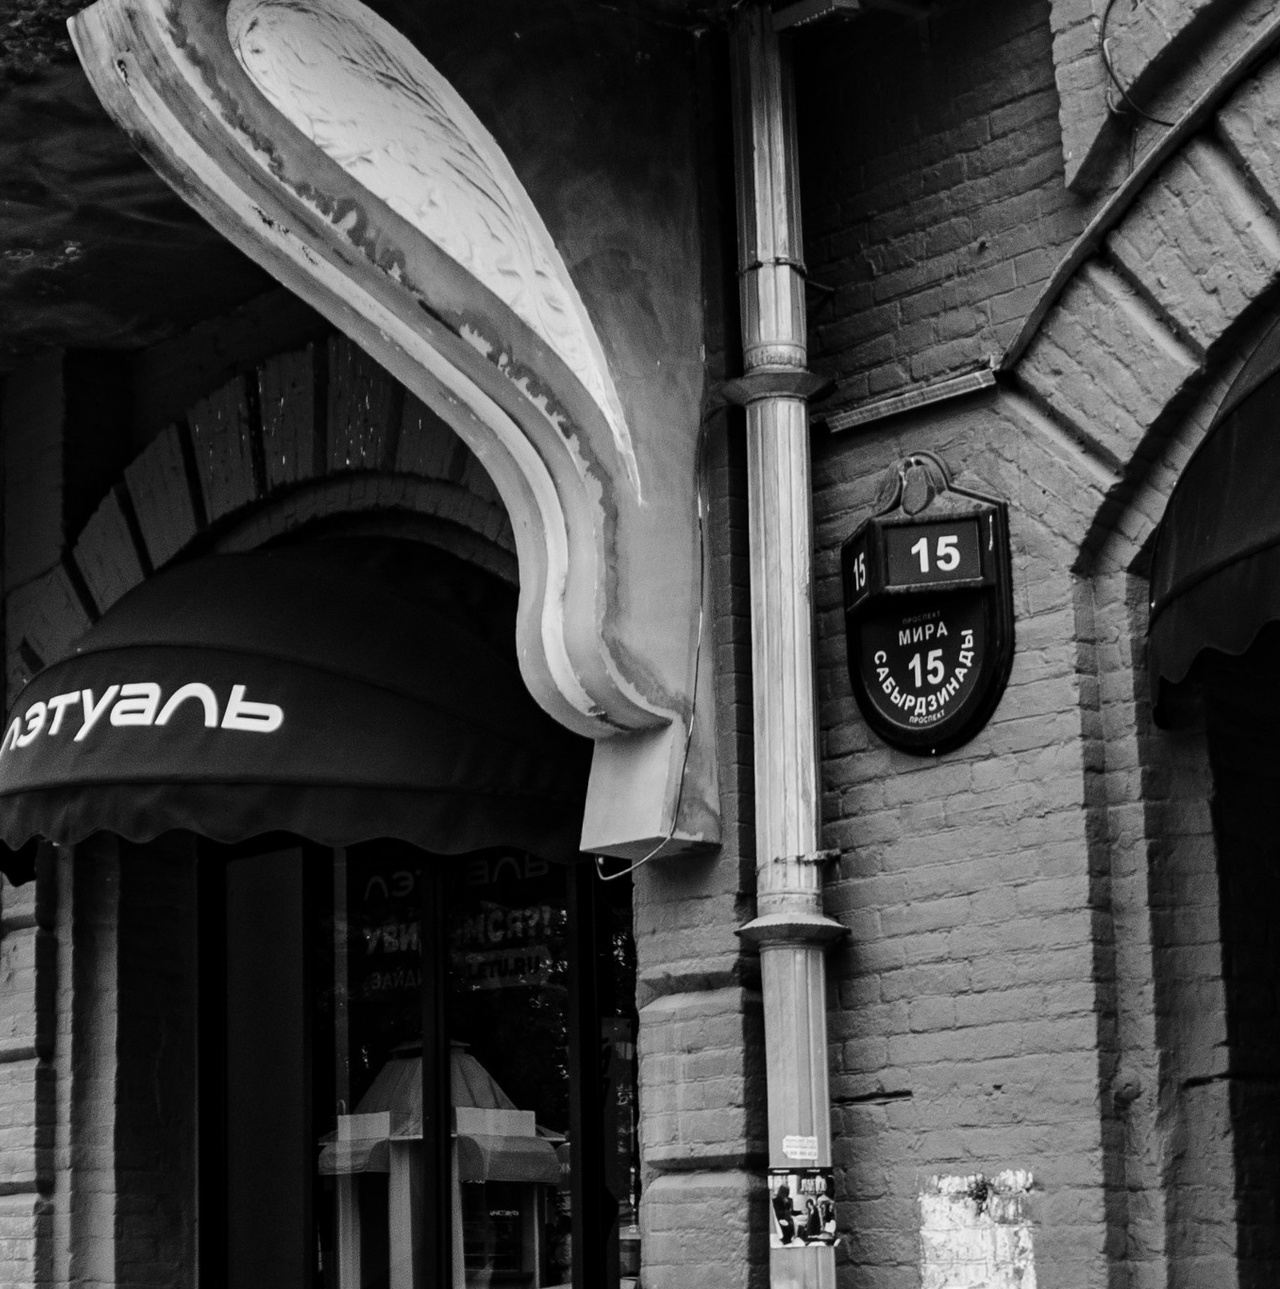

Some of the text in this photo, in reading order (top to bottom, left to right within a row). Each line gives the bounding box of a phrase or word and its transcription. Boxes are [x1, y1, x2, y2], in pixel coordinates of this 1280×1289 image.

[911, 535, 960, 573] 15
[853, 552, 866, 591] 15
[902, 610, 941, 624] ПРОСПЕКТ
[898, 621, 948, 646] МИРА
[908, 648, 945, 688] 15
[909, 709, 945, 724] ПРОСПЕКТ
